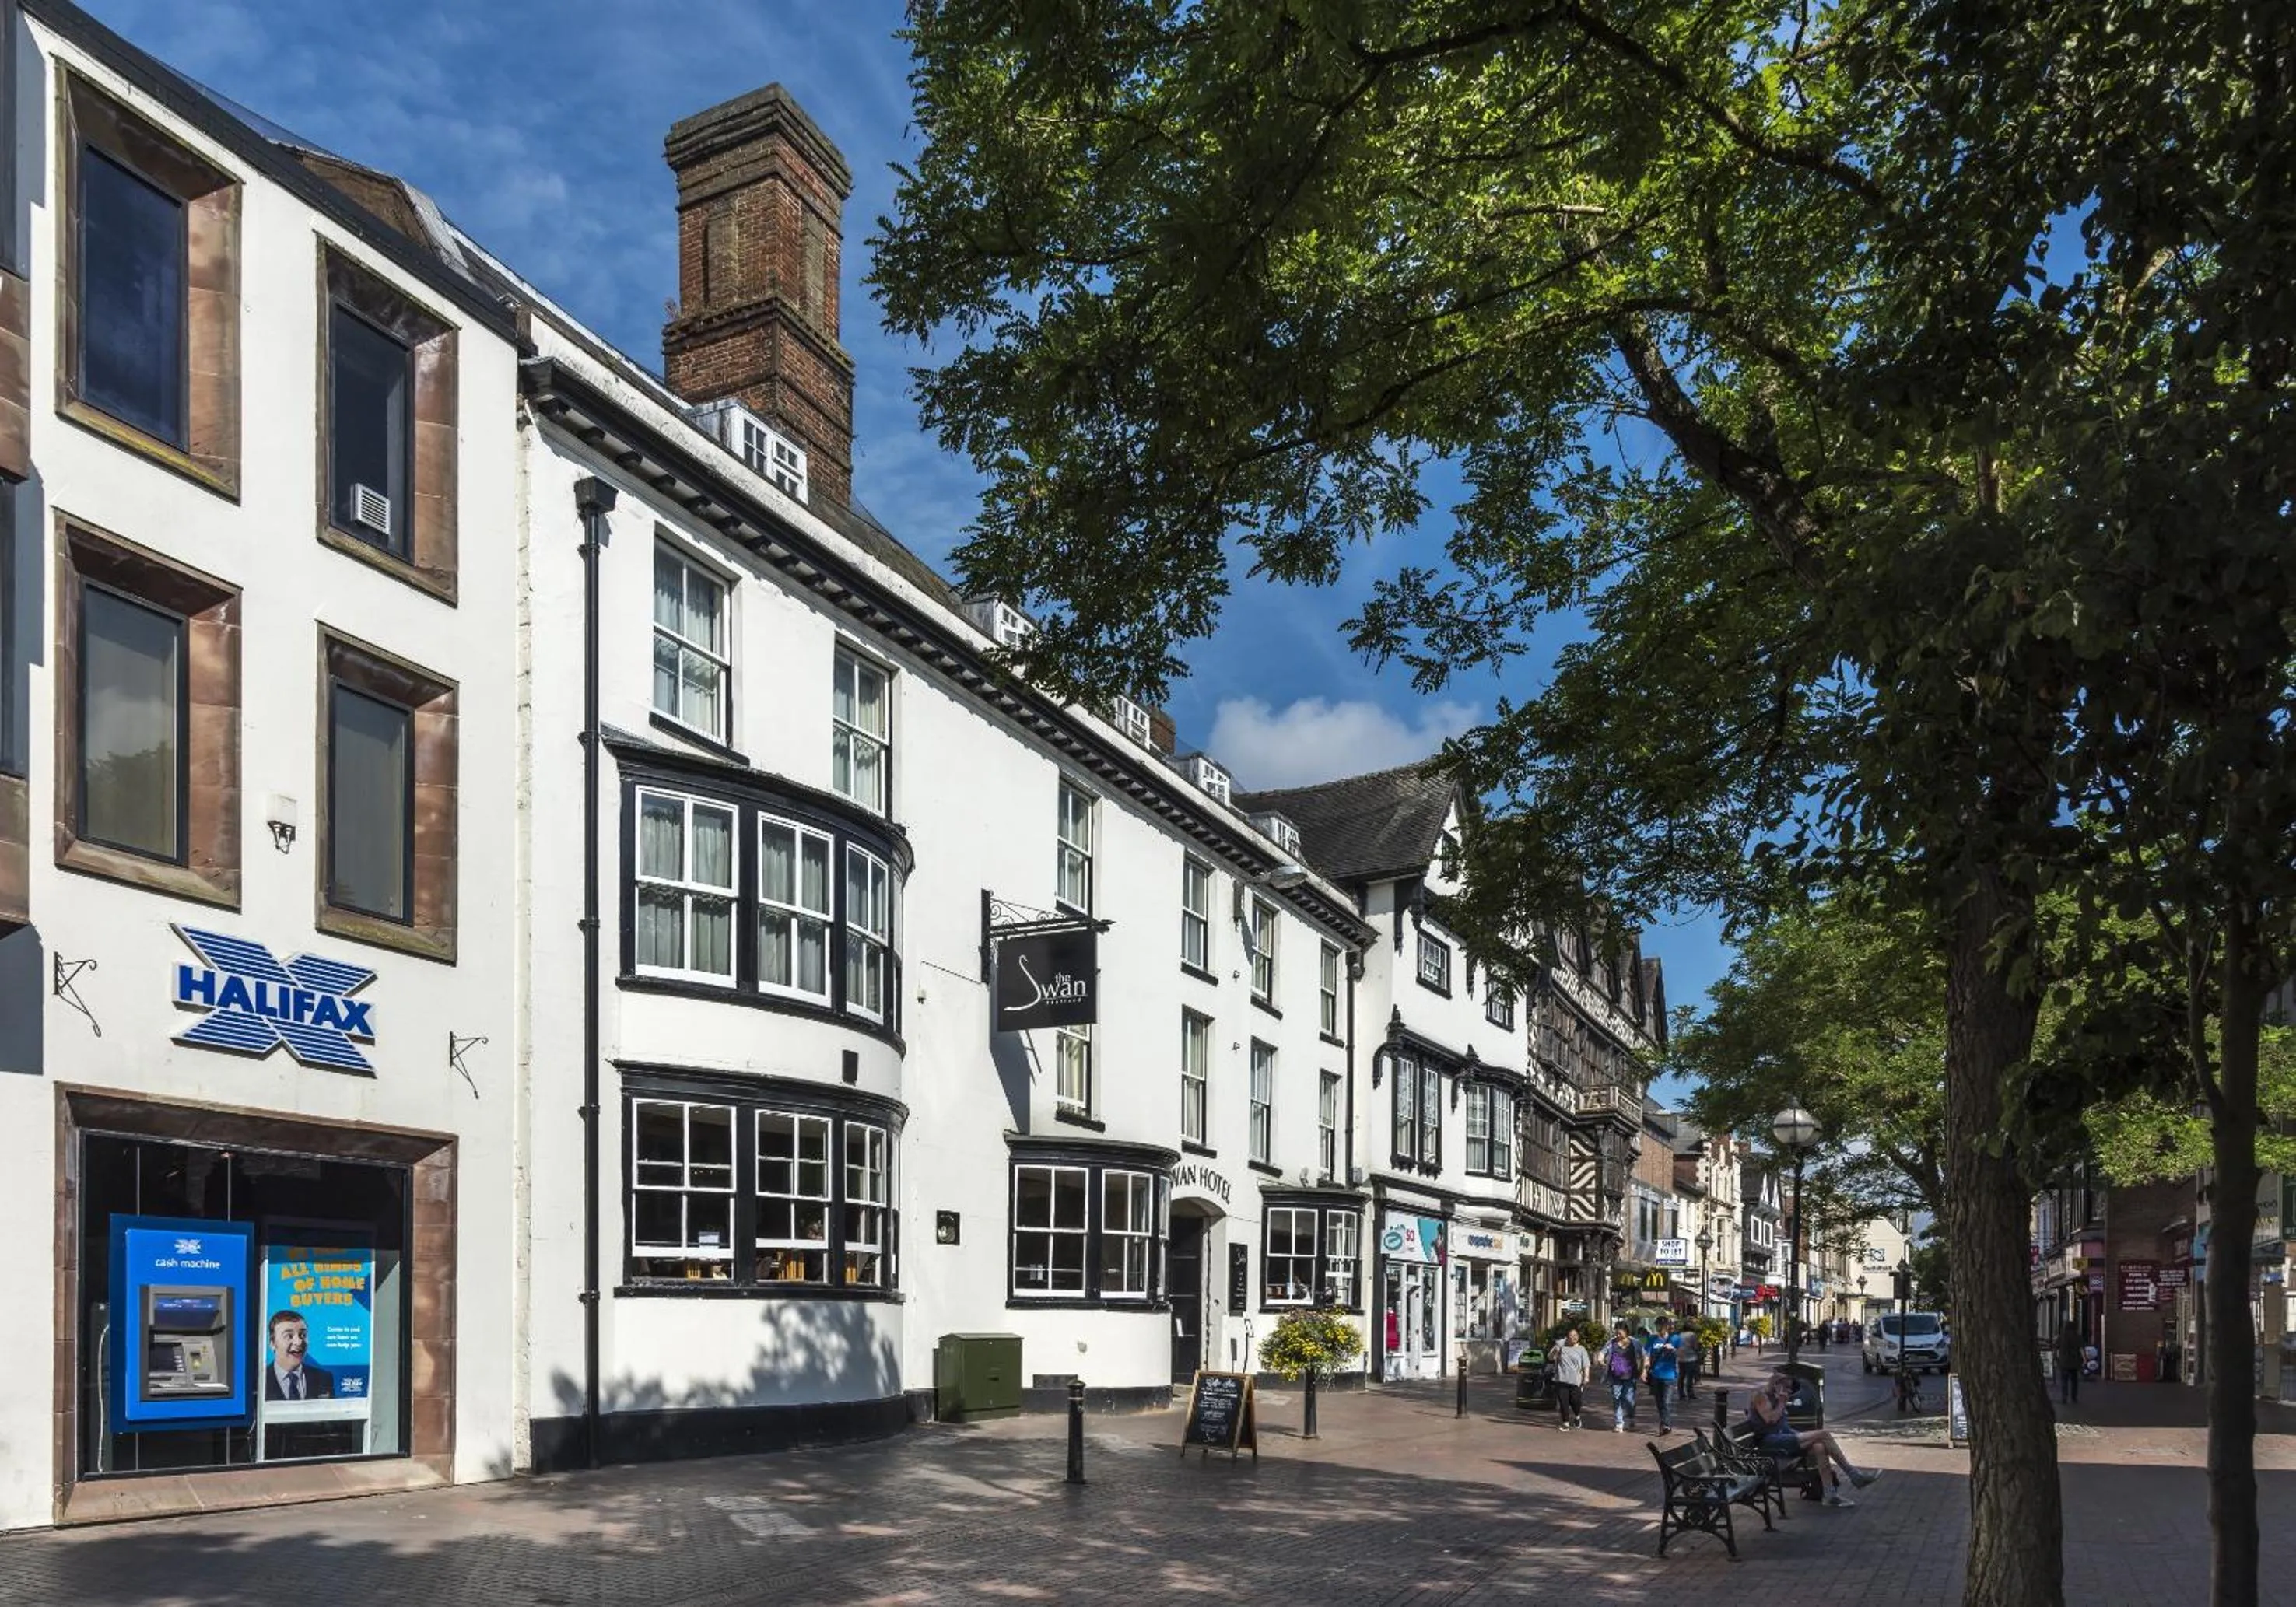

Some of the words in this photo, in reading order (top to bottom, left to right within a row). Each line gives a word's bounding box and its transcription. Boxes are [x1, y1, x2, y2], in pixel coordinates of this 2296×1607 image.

[1004, 954, 1087, 1010] Swan
[1055, 972, 1071, 983] the
[179, 965, 374, 1037] HALIFAX
[1169, 1164, 1196, 1189] WAN
[1199, 1166, 1231, 1205] HOTEL
[155, 1258, 178, 1268] cash
[180, 1259, 221, 1269] machine
[281, 1262, 309, 1280] ALL
[294, 1276, 315, 1291] OF
[321, 1276, 366, 1291] HOME
